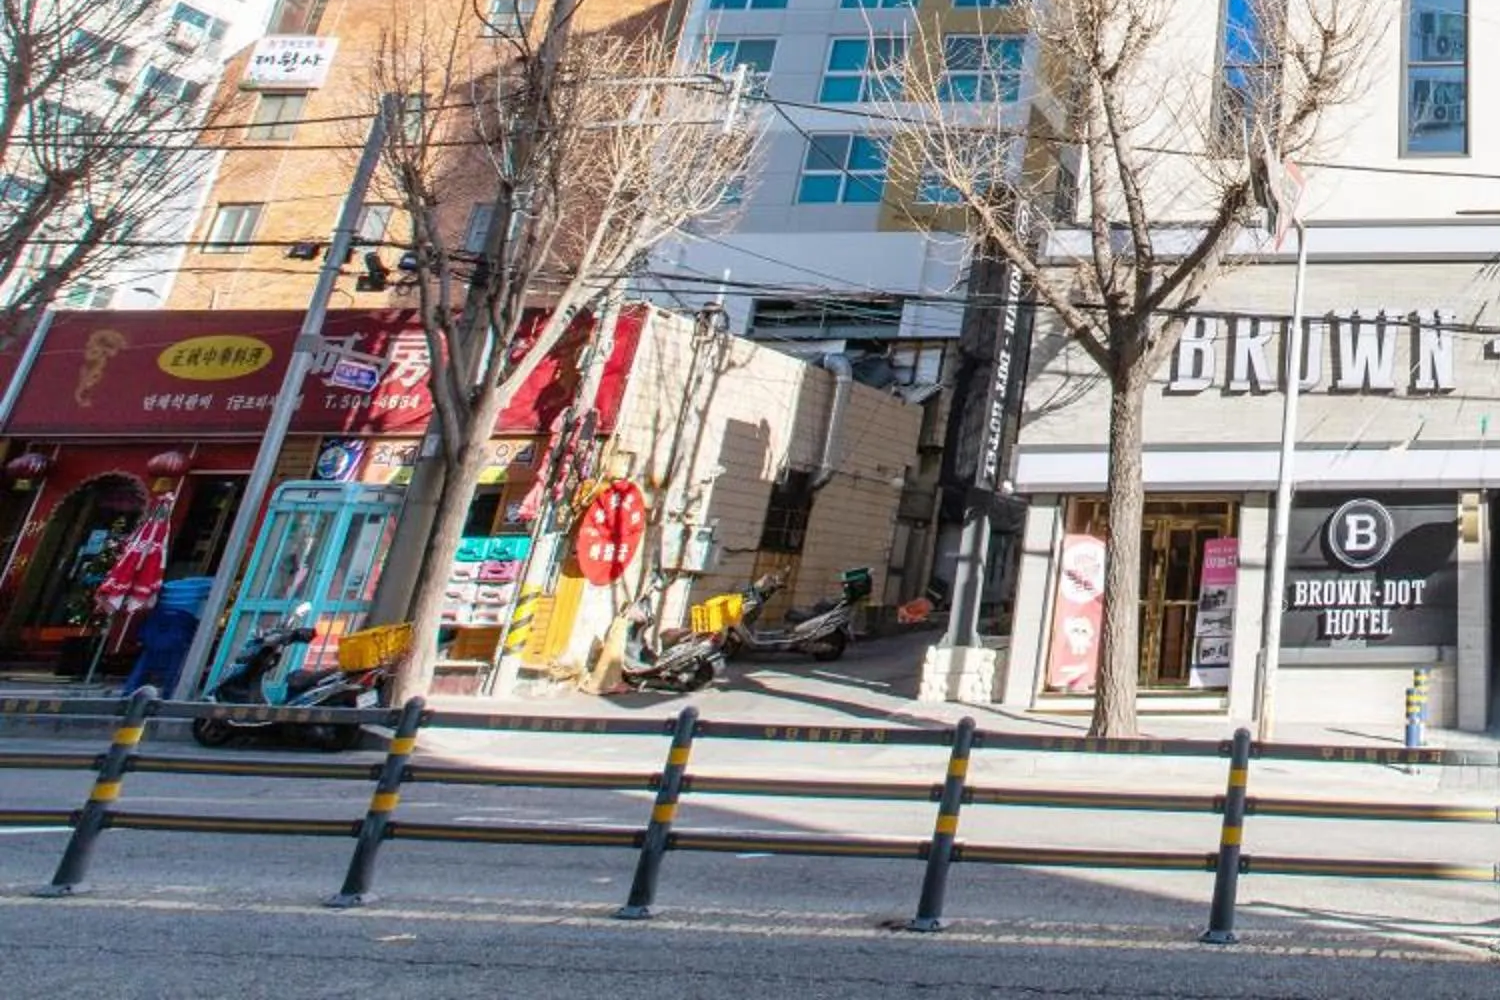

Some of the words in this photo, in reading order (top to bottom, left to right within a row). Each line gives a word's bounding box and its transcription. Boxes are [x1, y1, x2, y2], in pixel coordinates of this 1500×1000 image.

[1003, 262, 1022, 336] ROWN
[1168, 308, 1456, 392] BROWN
[1345, 514, 1377, 551] B
[1325, 608, 1393, 636] HOTEL
